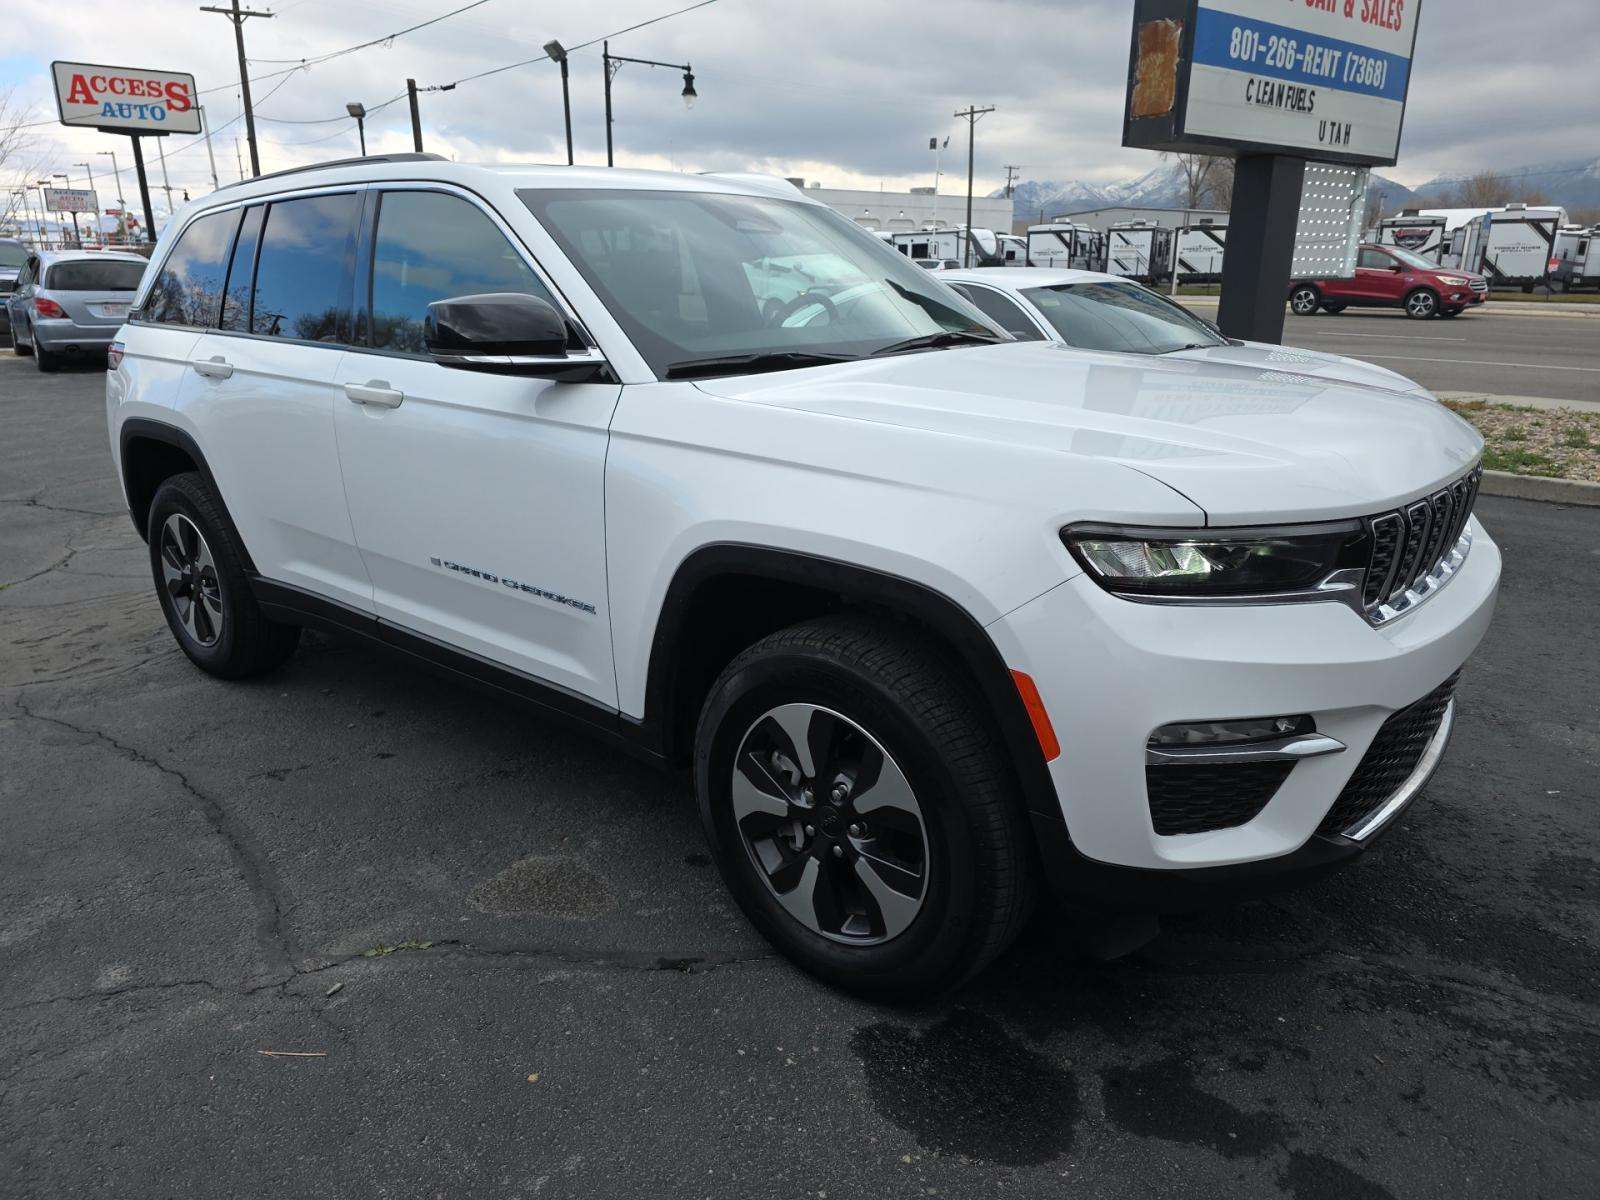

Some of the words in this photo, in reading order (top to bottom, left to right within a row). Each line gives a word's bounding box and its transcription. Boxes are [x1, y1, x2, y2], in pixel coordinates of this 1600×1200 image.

[1361, 0, 1404, 32] SALES
[1229, 26, 1342, 78] 801-266-RENT
[1343, 51, 1388, 90] (7368)
[101, 102, 166, 121] AUTO
[1319, 120, 1352, 145] UTAH
[443, 561, 499, 583] GRAND
[501, 578, 597, 615] CHEROKEE
